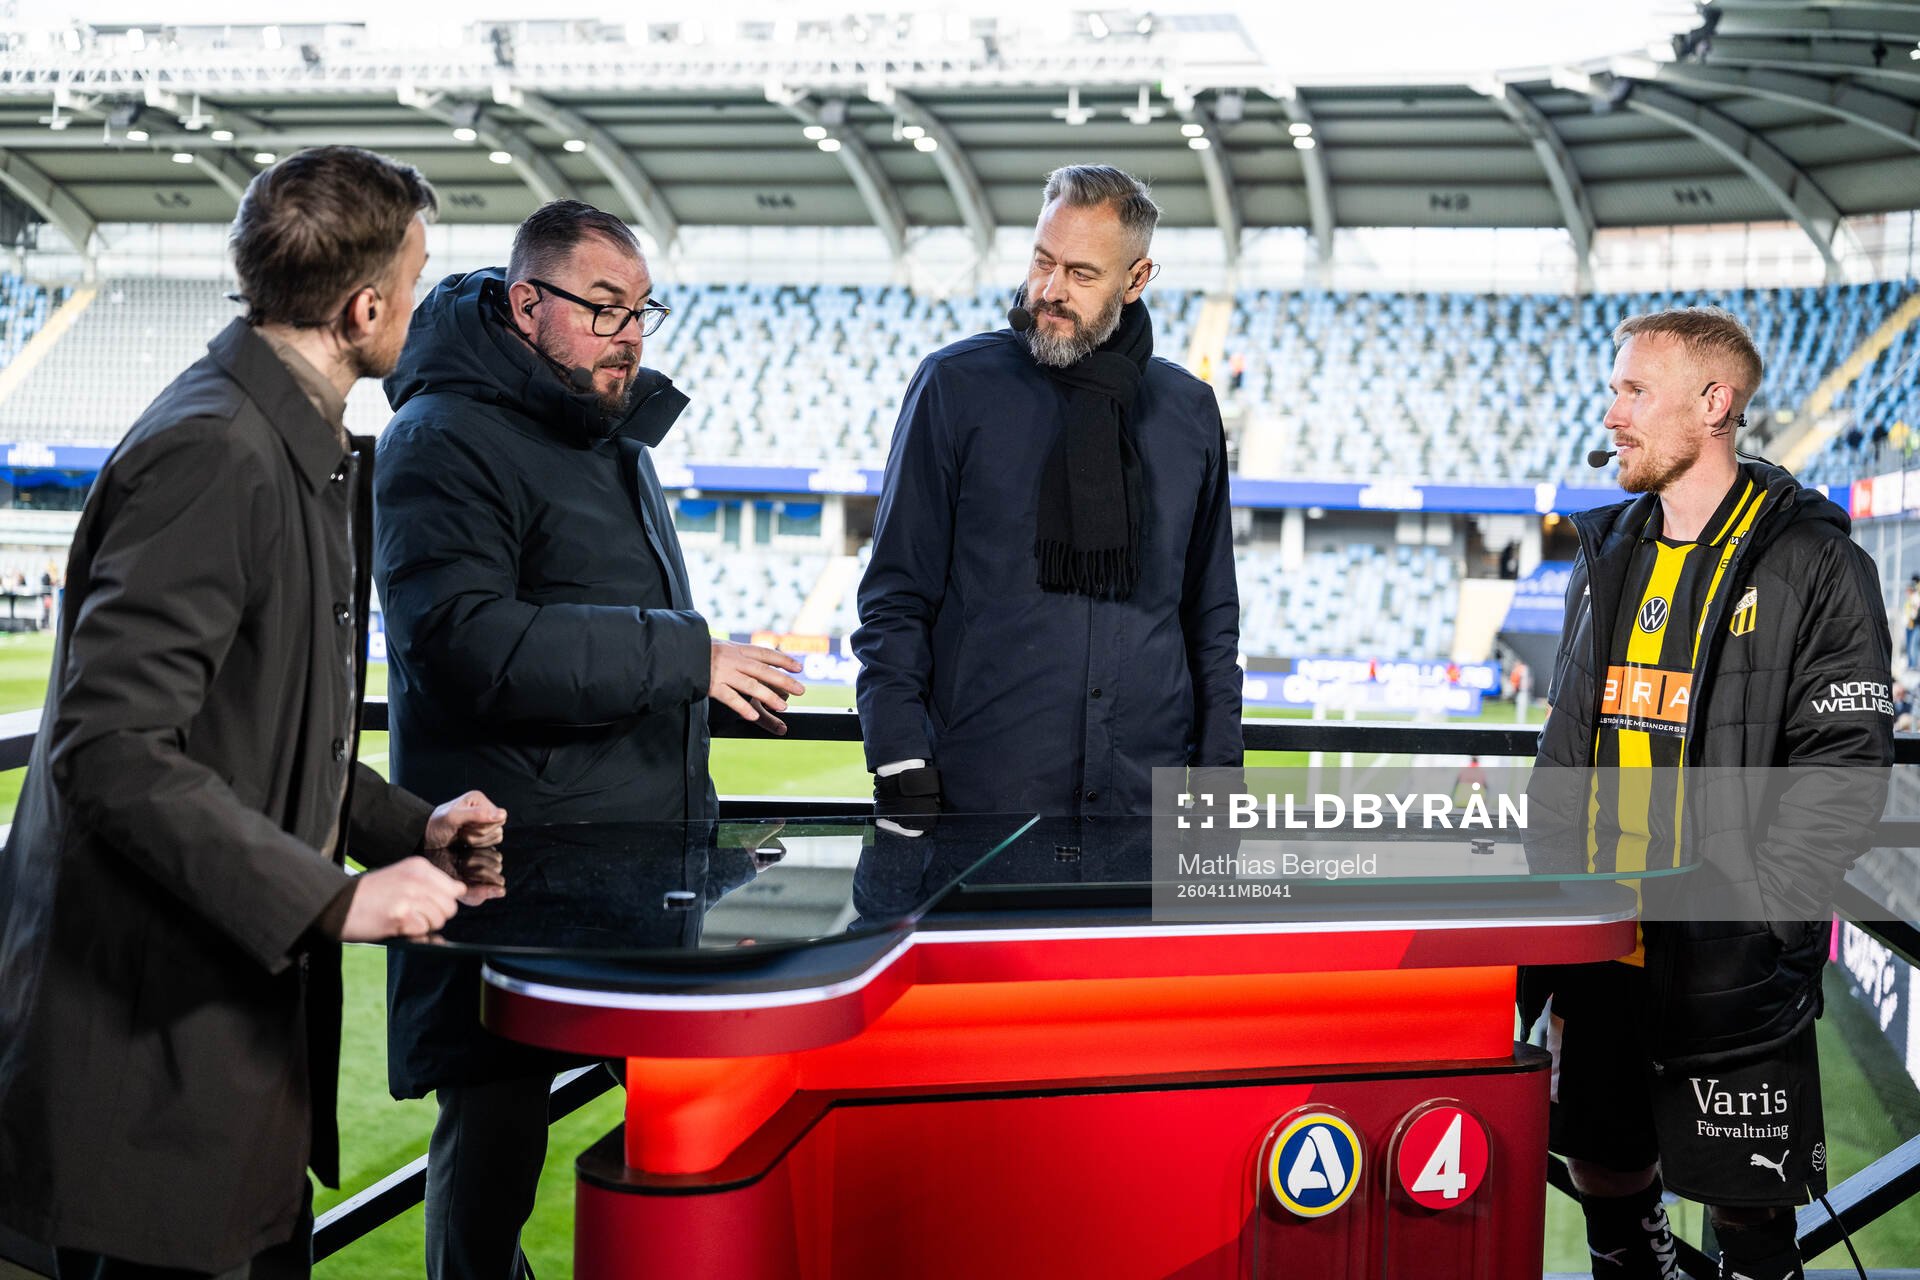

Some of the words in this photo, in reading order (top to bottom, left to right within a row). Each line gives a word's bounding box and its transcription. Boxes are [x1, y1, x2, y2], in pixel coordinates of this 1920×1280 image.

[1830, 681, 1889, 699] NORDIC
[1811, 697, 1895, 716] WELLNESS
[1689, 1078, 1788, 1115] Varis
[1696, 1120, 1789, 1140] Förvaltning
[1287, 1126, 1346, 1199] A
[1411, 1113, 1466, 1199] 4
